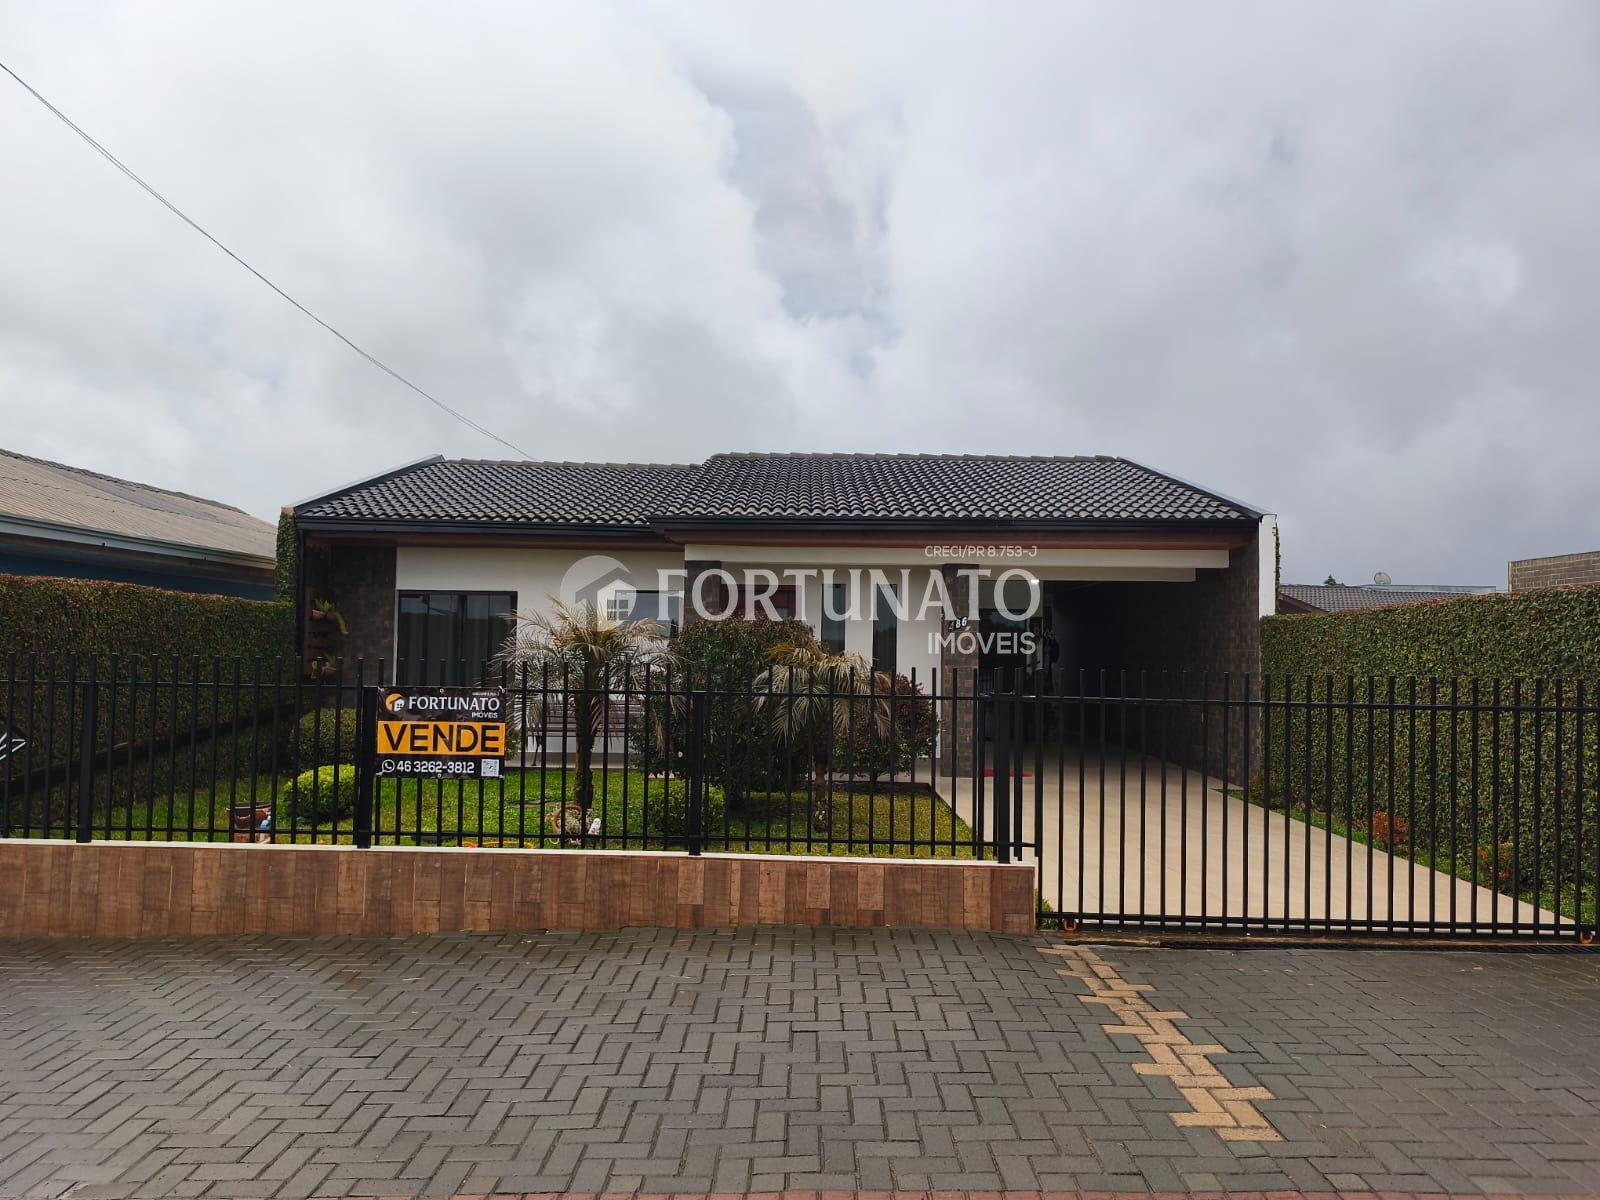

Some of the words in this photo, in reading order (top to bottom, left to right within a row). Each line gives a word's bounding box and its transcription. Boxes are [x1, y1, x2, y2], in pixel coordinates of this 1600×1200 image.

[408, 696, 500, 711] FORTUNATO
[383, 723, 500, 753] VENDE
[396, 760, 412, 772] 46
[413, 761, 475, 774] 3262-3812
